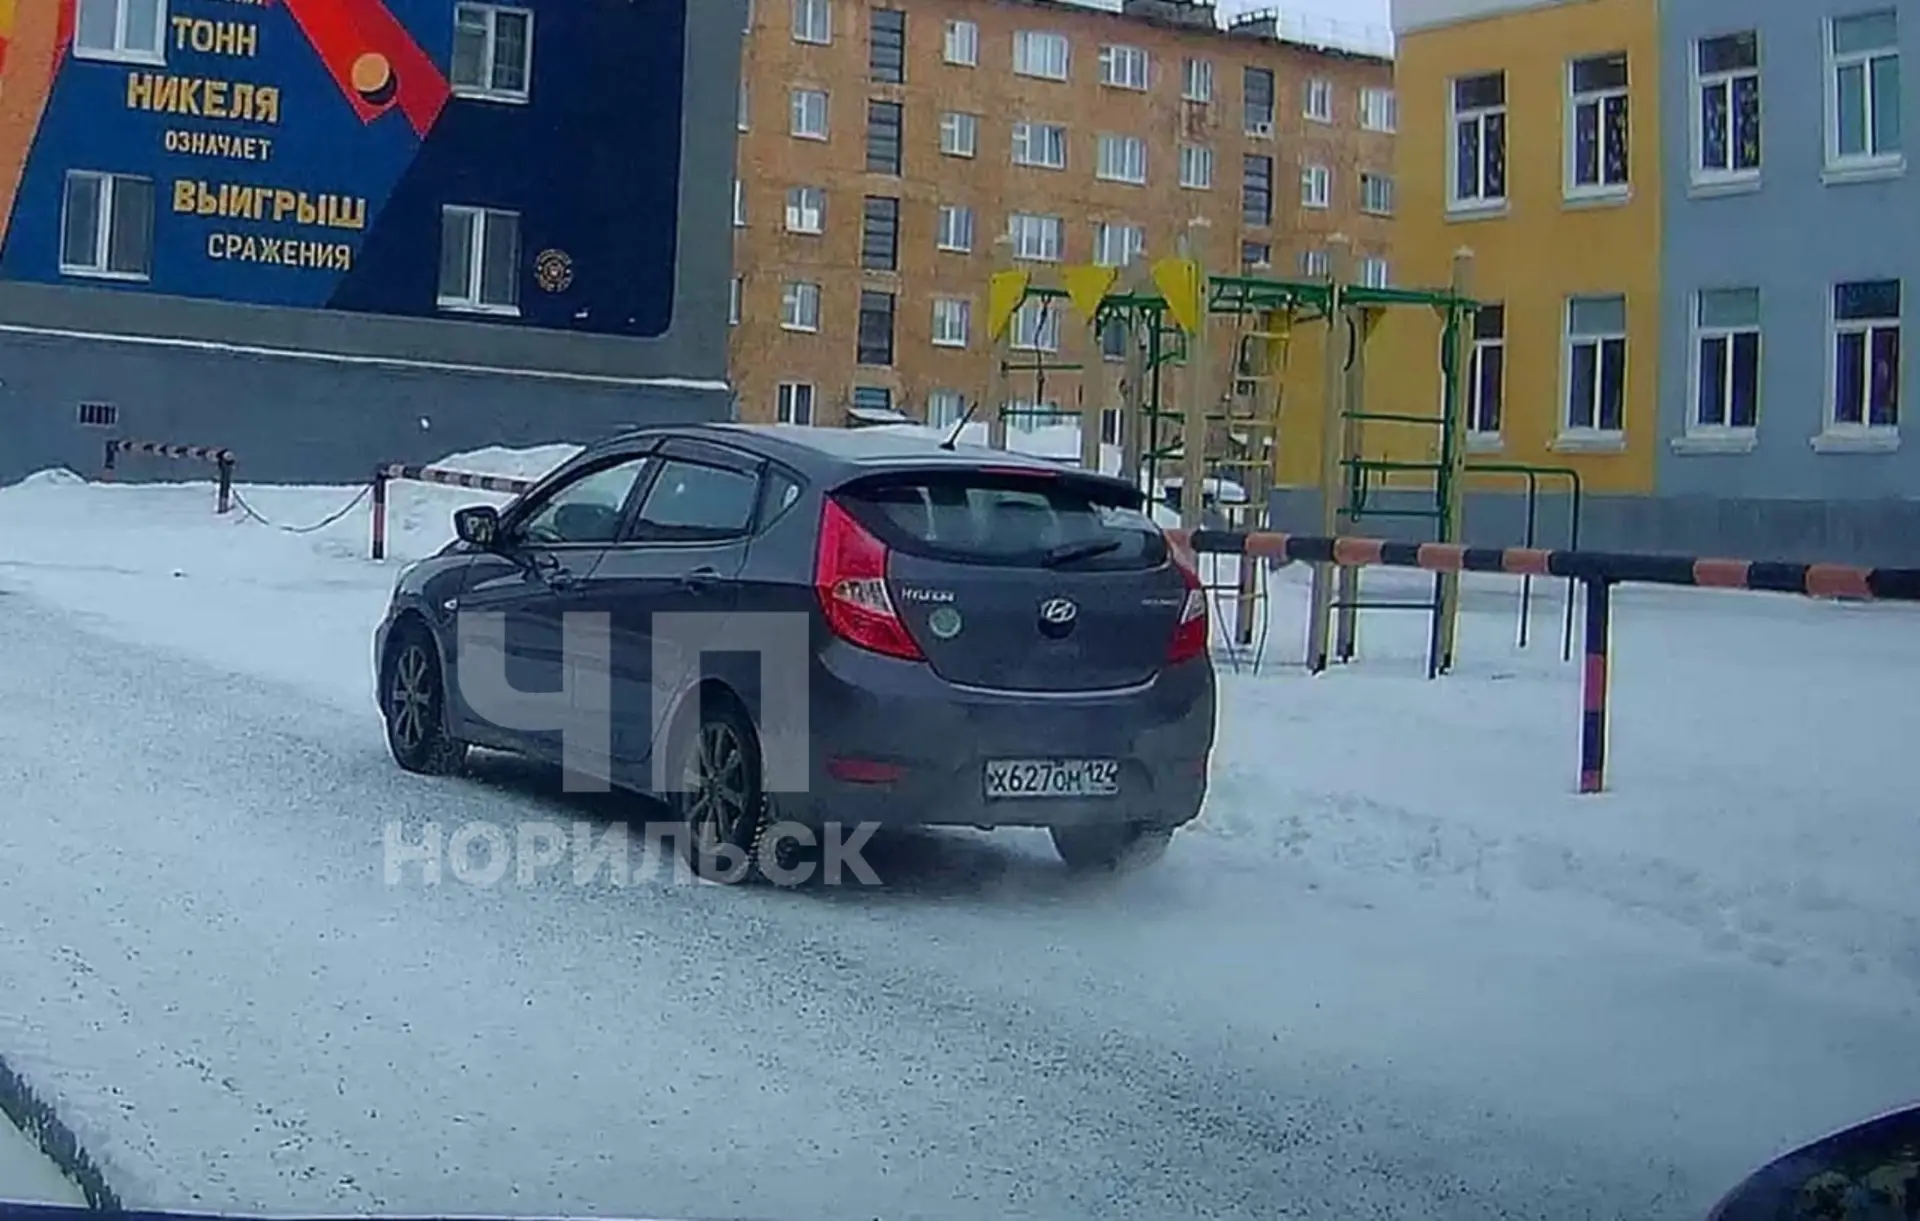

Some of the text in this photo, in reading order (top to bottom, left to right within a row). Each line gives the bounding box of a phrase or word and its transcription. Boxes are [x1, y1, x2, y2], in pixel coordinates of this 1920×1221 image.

[172, 16, 257, 56] ТОНН
[127, 72, 280, 123] НИКЕЛЯ
[165, 131, 272, 160] ОЗНАЧАЕТ
[173, 180, 366, 229] ВЫИГРЫШ
[208, 234, 351, 271] СРАЖЕНИЯ
